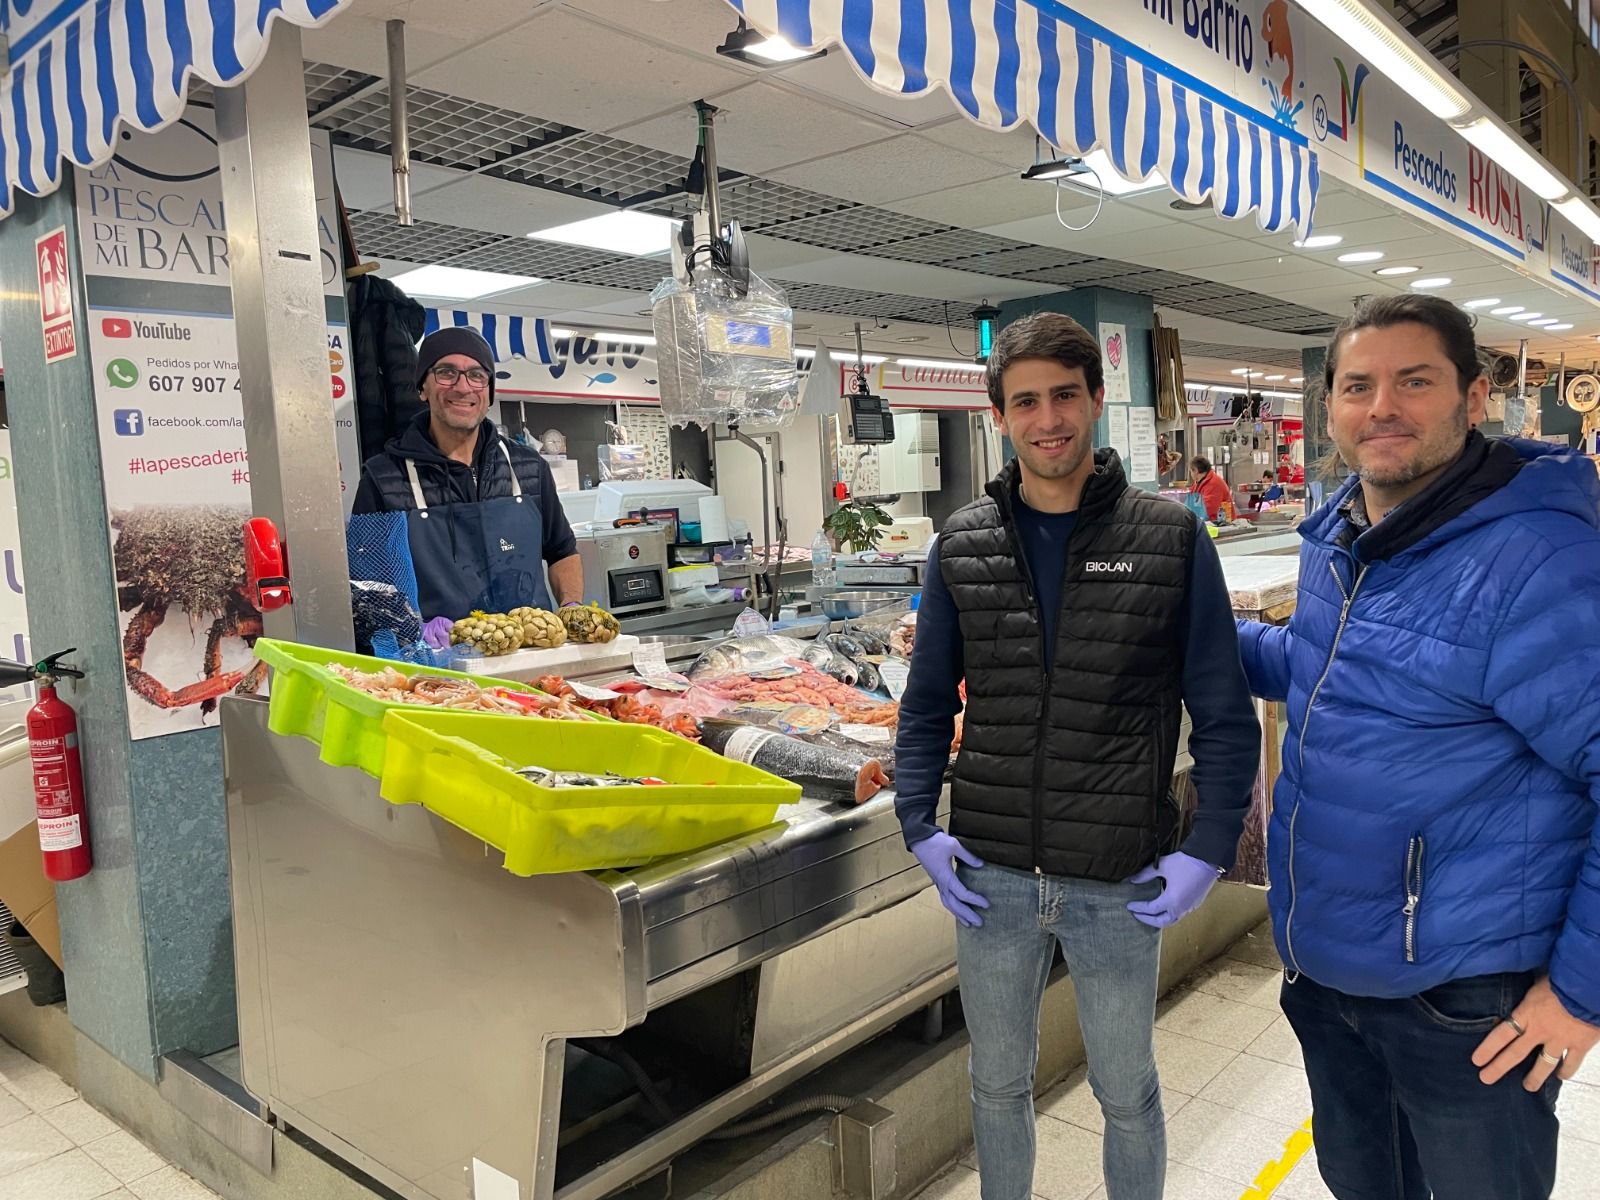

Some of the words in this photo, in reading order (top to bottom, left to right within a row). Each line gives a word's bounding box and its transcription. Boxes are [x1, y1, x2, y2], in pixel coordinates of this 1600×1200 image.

[1184, 0, 1253, 74] Barrio
[1315, 106, 1325, 129] 42
[1394, 120, 1457, 203] Pescados
[1467, 144, 1525, 242] ROSA
[93, 222, 128, 243] DE
[96, 243, 129, 268] MI
[45, 326, 74, 354] EXTINTOR
[133, 321, 192, 341] YouTube
[147, 357, 191, 369] Pedidos
[193, 361, 211, 371] por
[149, 375, 185, 392] 607
[192, 376, 226, 393] 907
[1085, 561, 1133, 573] BIOLAN
